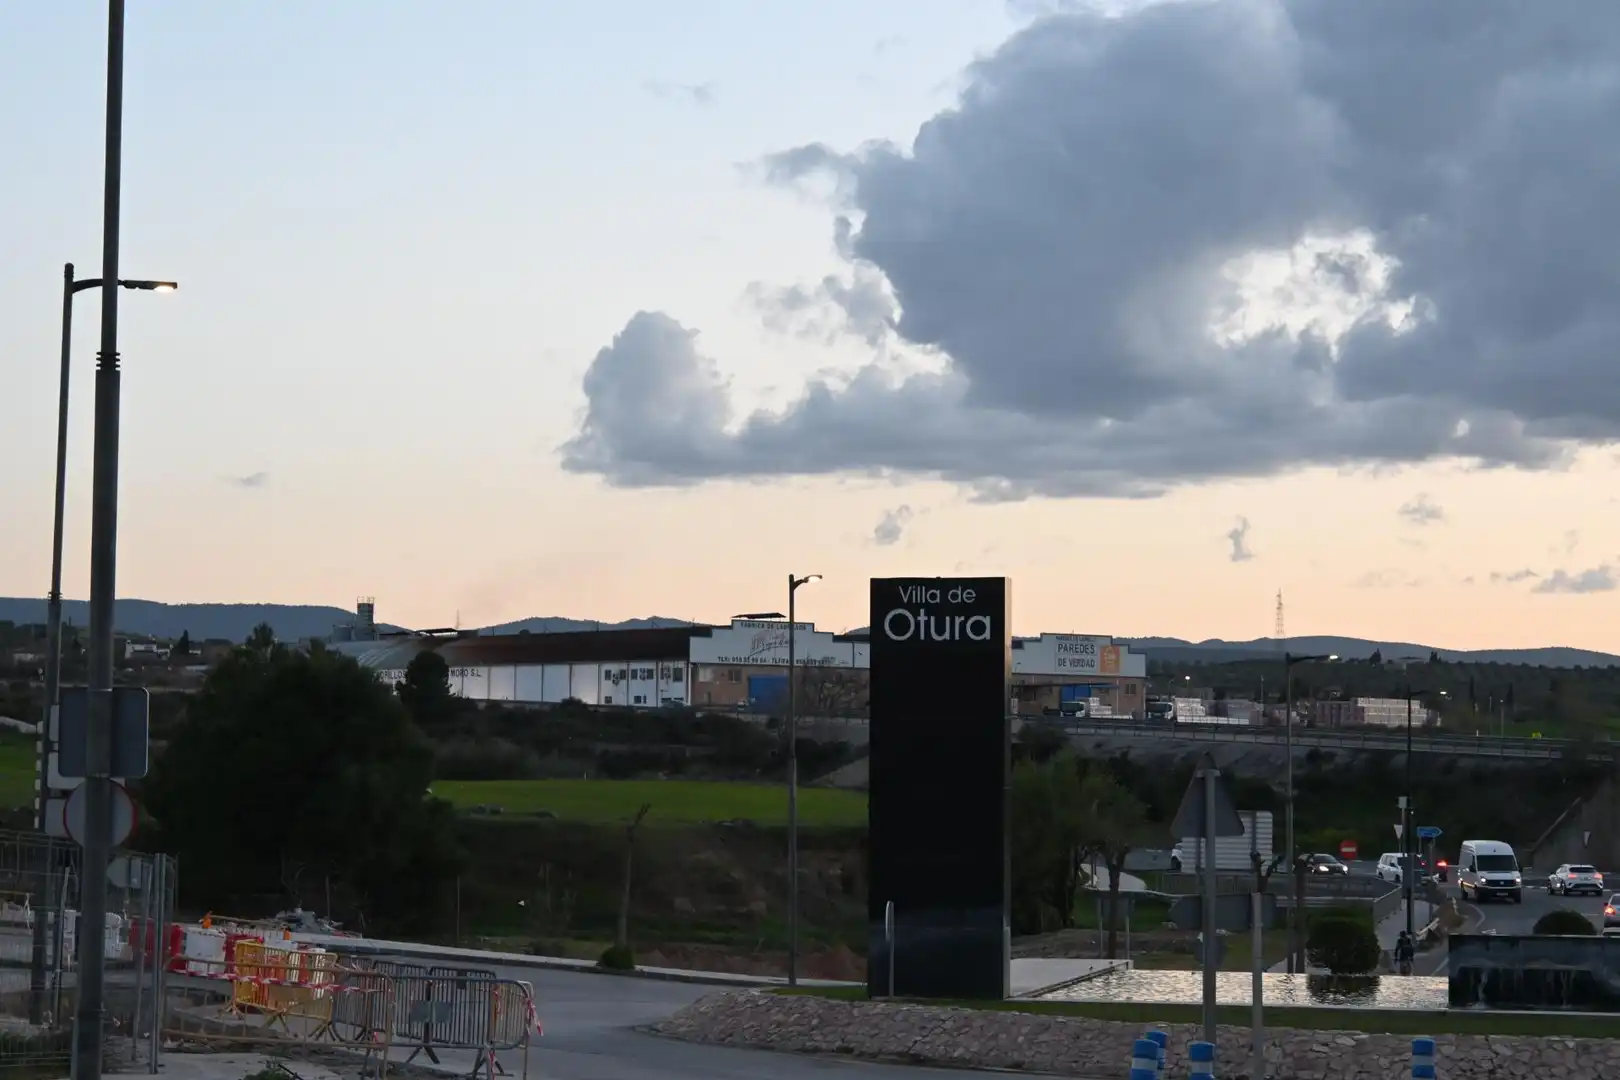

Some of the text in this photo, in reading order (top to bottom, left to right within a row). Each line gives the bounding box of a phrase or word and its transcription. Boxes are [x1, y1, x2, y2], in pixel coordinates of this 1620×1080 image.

[898, 585, 977, 604] Villa de
[883, 608, 992, 642] Otura
[1057, 643, 1096, 654] PAREDES
[1057, 658, 1096, 668] DE VERDAD
[450, 668, 469, 678] MORO
